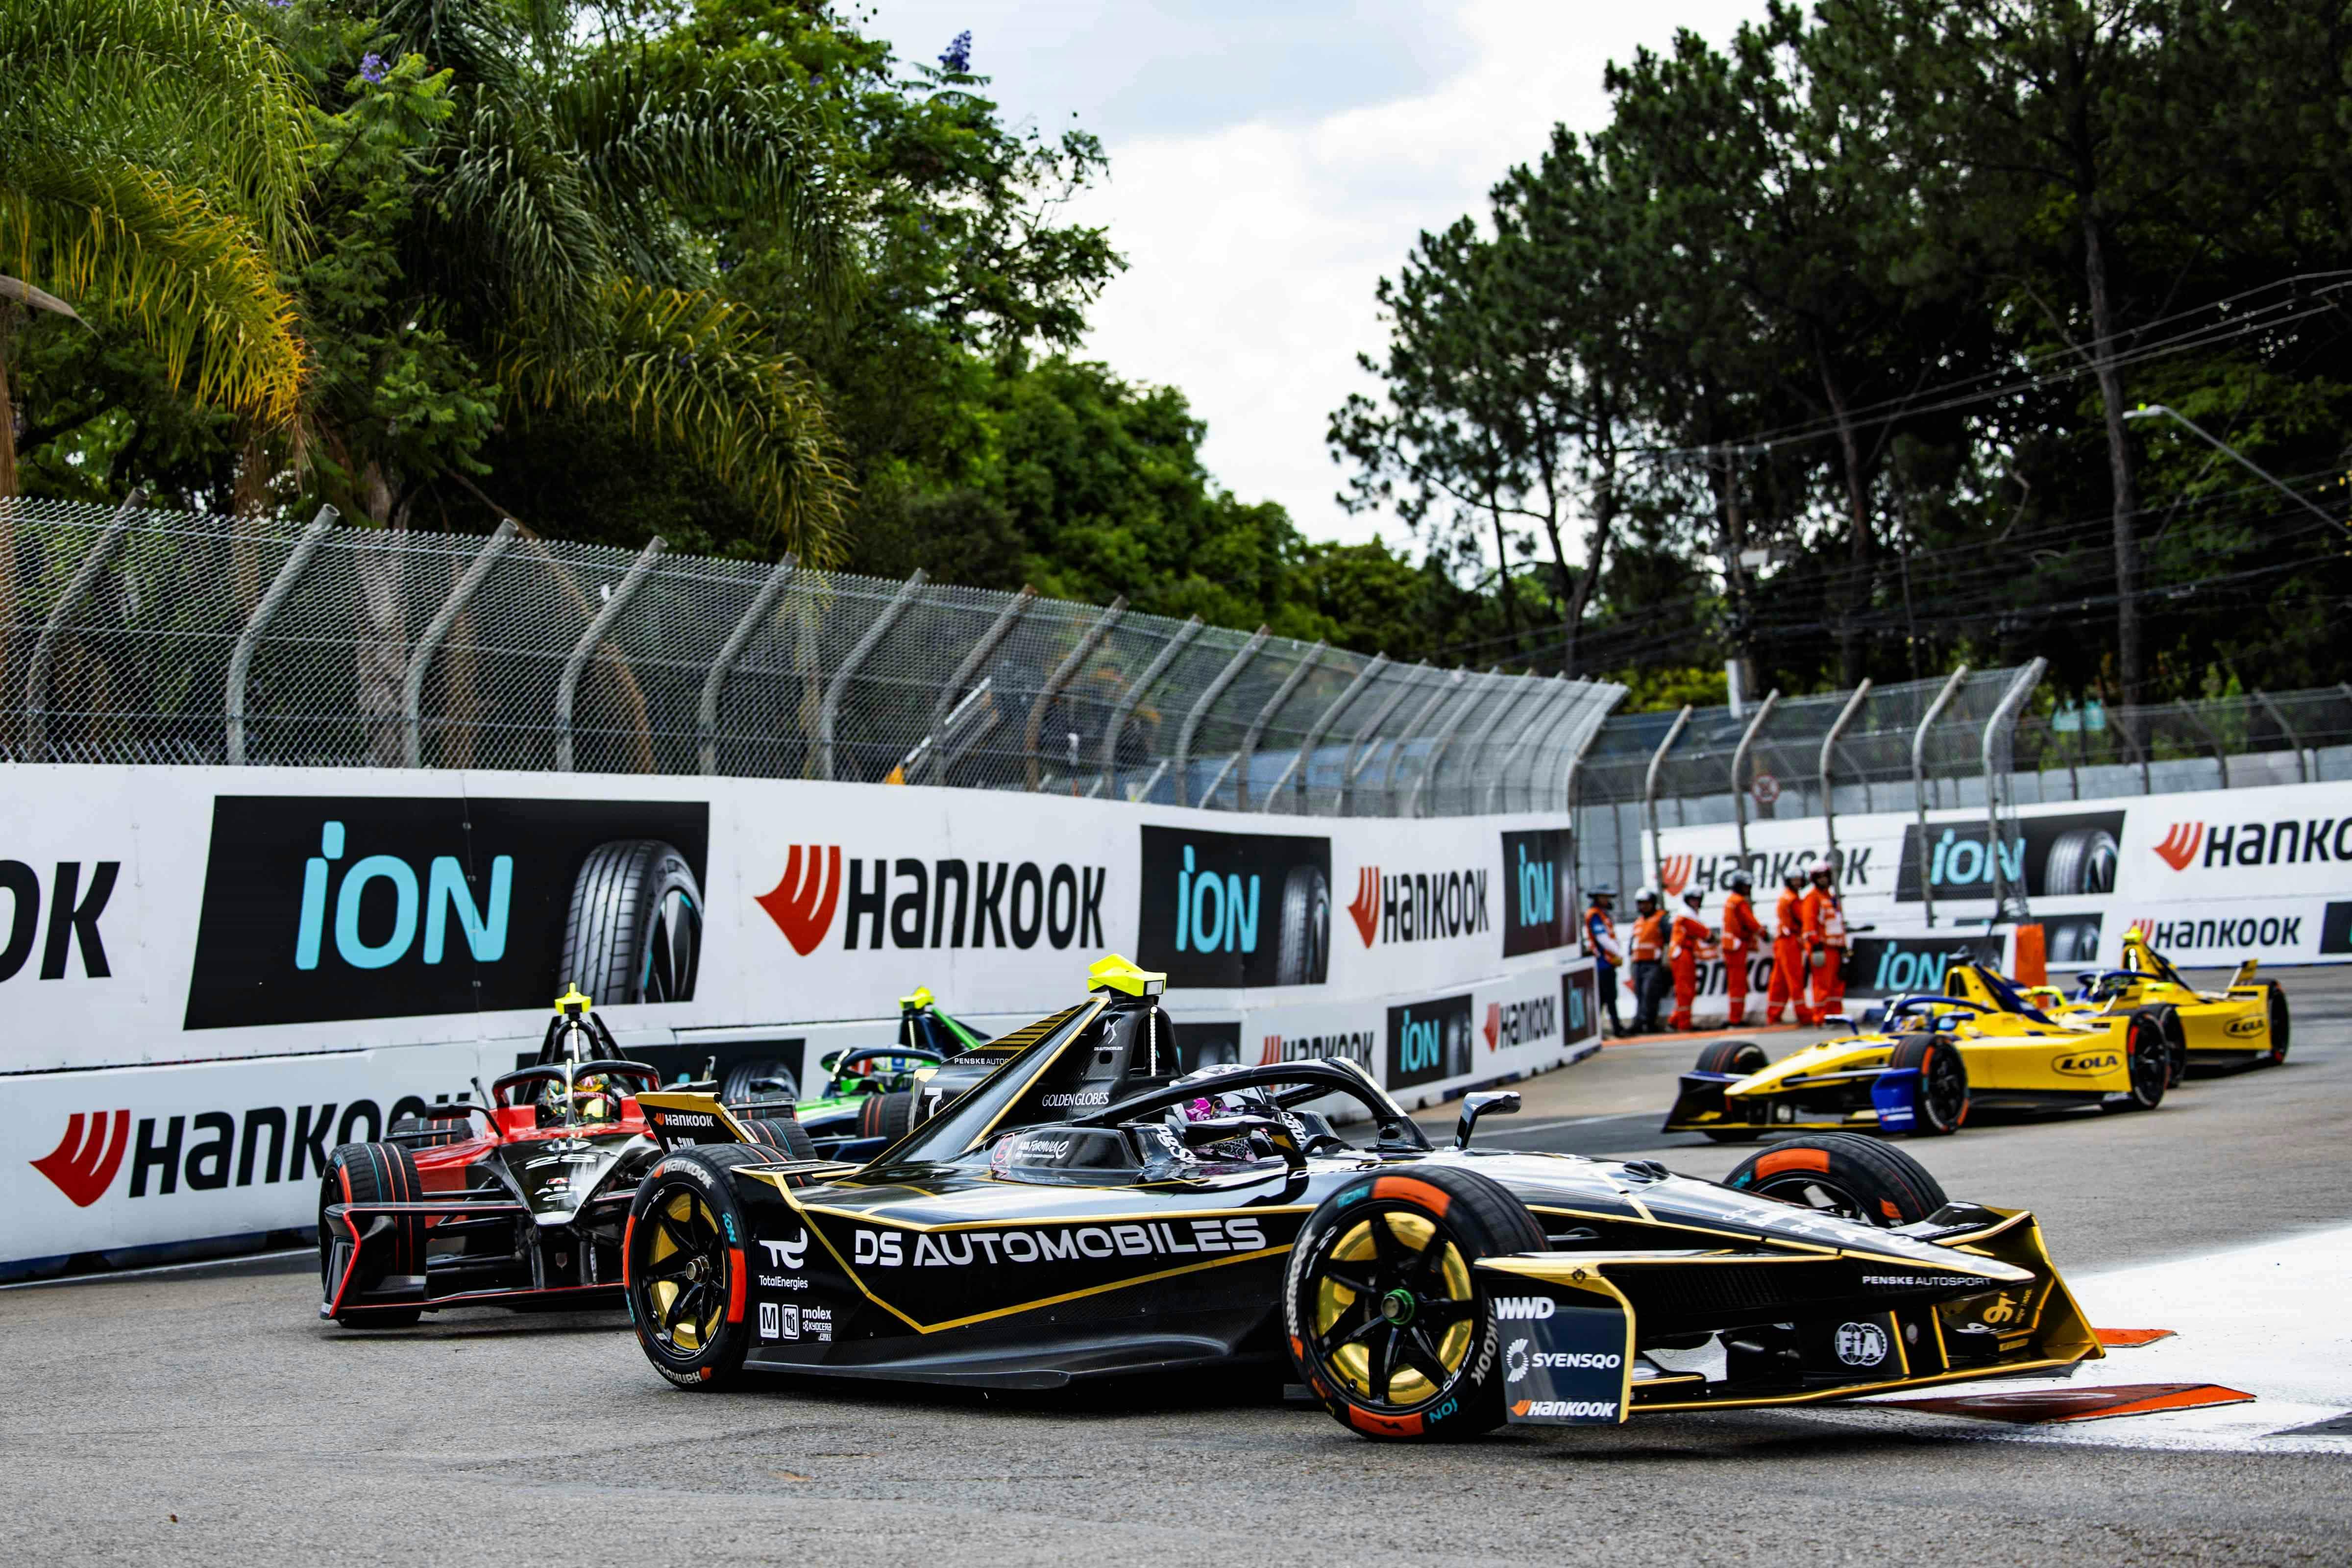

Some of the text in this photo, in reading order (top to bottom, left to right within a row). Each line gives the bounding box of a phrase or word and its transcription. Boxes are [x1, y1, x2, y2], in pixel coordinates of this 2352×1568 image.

[2061, 1055, 2118, 1070] LOLA
[1042, 1092, 1109, 1106] GOLDEN GLOBES
[855, 1230, 903, 1266] DS
[913, 1218, 1266, 1266] AUTOMOBILES
[759, 1275, 808, 1290] TotalEnergies
[1862, 1275, 1991, 1286] PENSKE AUTOSPORT
[802, 1306, 832, 1320] molex
[1494, 1297, 1555, 1320] WWD
[762, 1307, 776, 1330] M
[1531, 1353, 1620, 1369] SYENSQO
